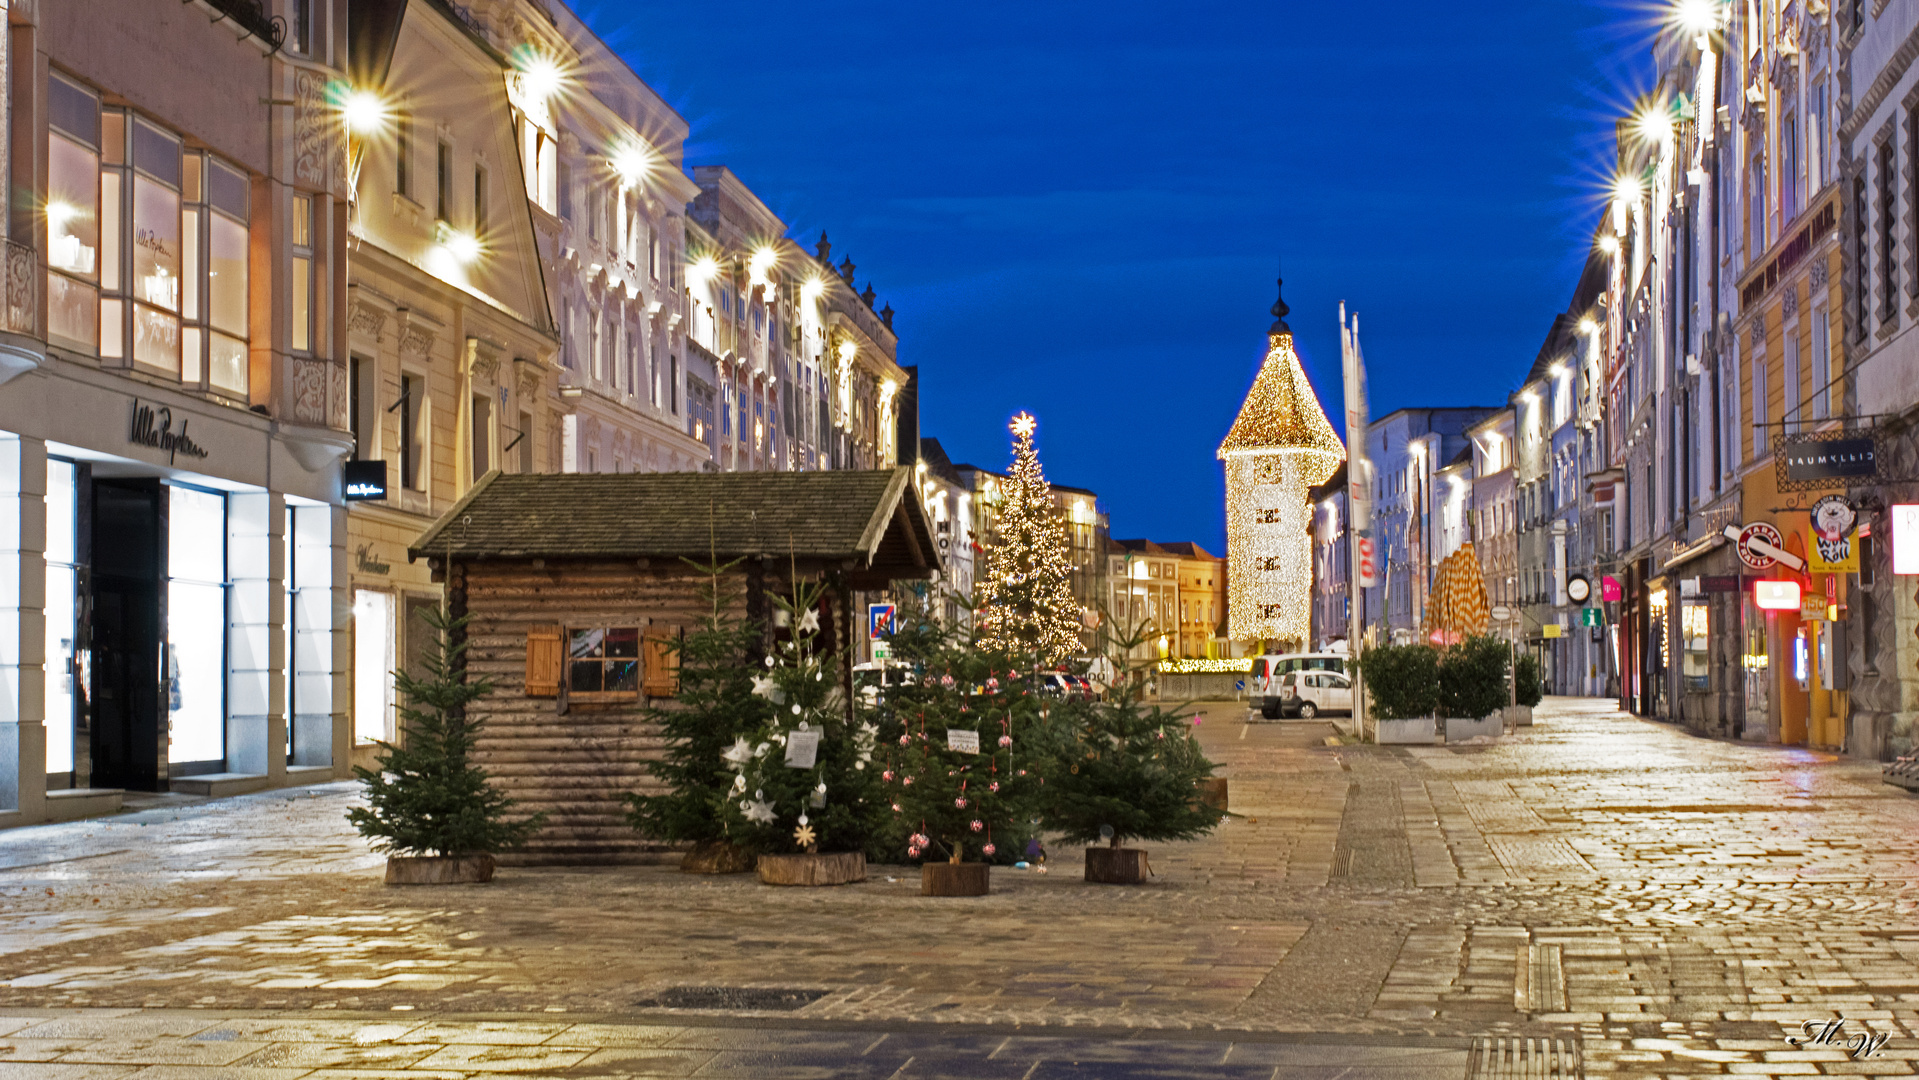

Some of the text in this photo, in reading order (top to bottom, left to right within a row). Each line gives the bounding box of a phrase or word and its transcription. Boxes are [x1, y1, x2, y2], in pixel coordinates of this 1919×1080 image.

[131, 398, 159, 447] Ulla
[1746, 524, 1780, 545] TABAK
[1739, 541, 1770, 566] TRAFIK
[1820, 546, 1849, 563] Roll
